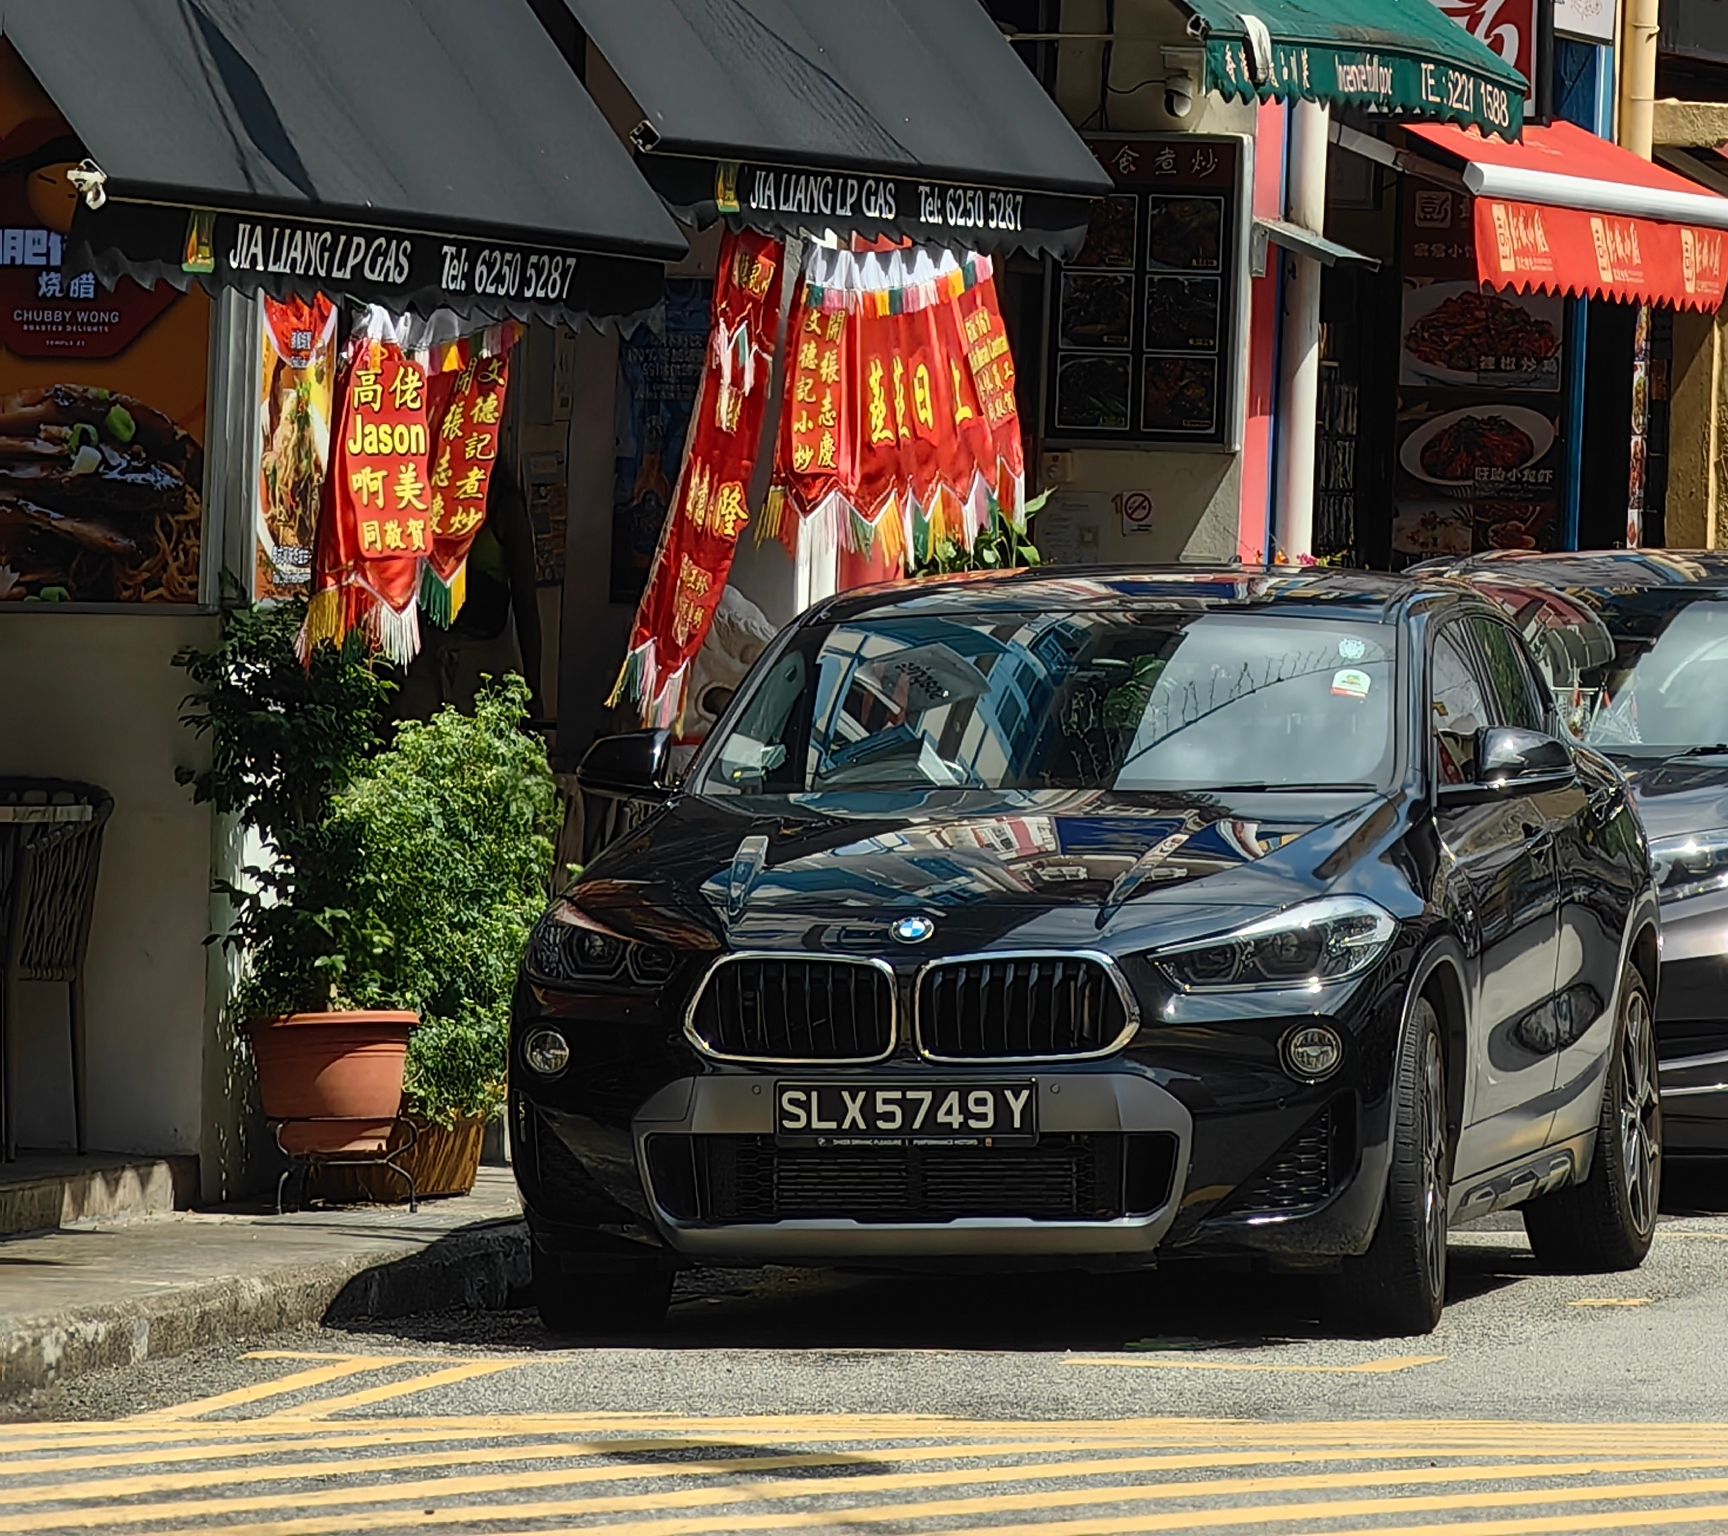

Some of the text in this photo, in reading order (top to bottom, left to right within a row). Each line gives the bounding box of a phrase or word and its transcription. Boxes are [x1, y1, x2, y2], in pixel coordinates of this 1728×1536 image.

[1480, 83, 1509, 128] 1588
[1090, 142, 1219, 178] 食煮炒
[750, 171, 1023, 231] JIA LIANG LP GAS Tel: 6250 5287
[229, 223, 576, 299] JIA LIANG LP GAS Tel: 6250 5287
[14, 309, 120, 323] CHUBBY WONG
[353, 365, 423, 412] 高佬
[348, 414, 427, 456] Jason
[351, 463, 428, 510] 啊美
[782, 1090, 1030, 1130] SLX5749Y
